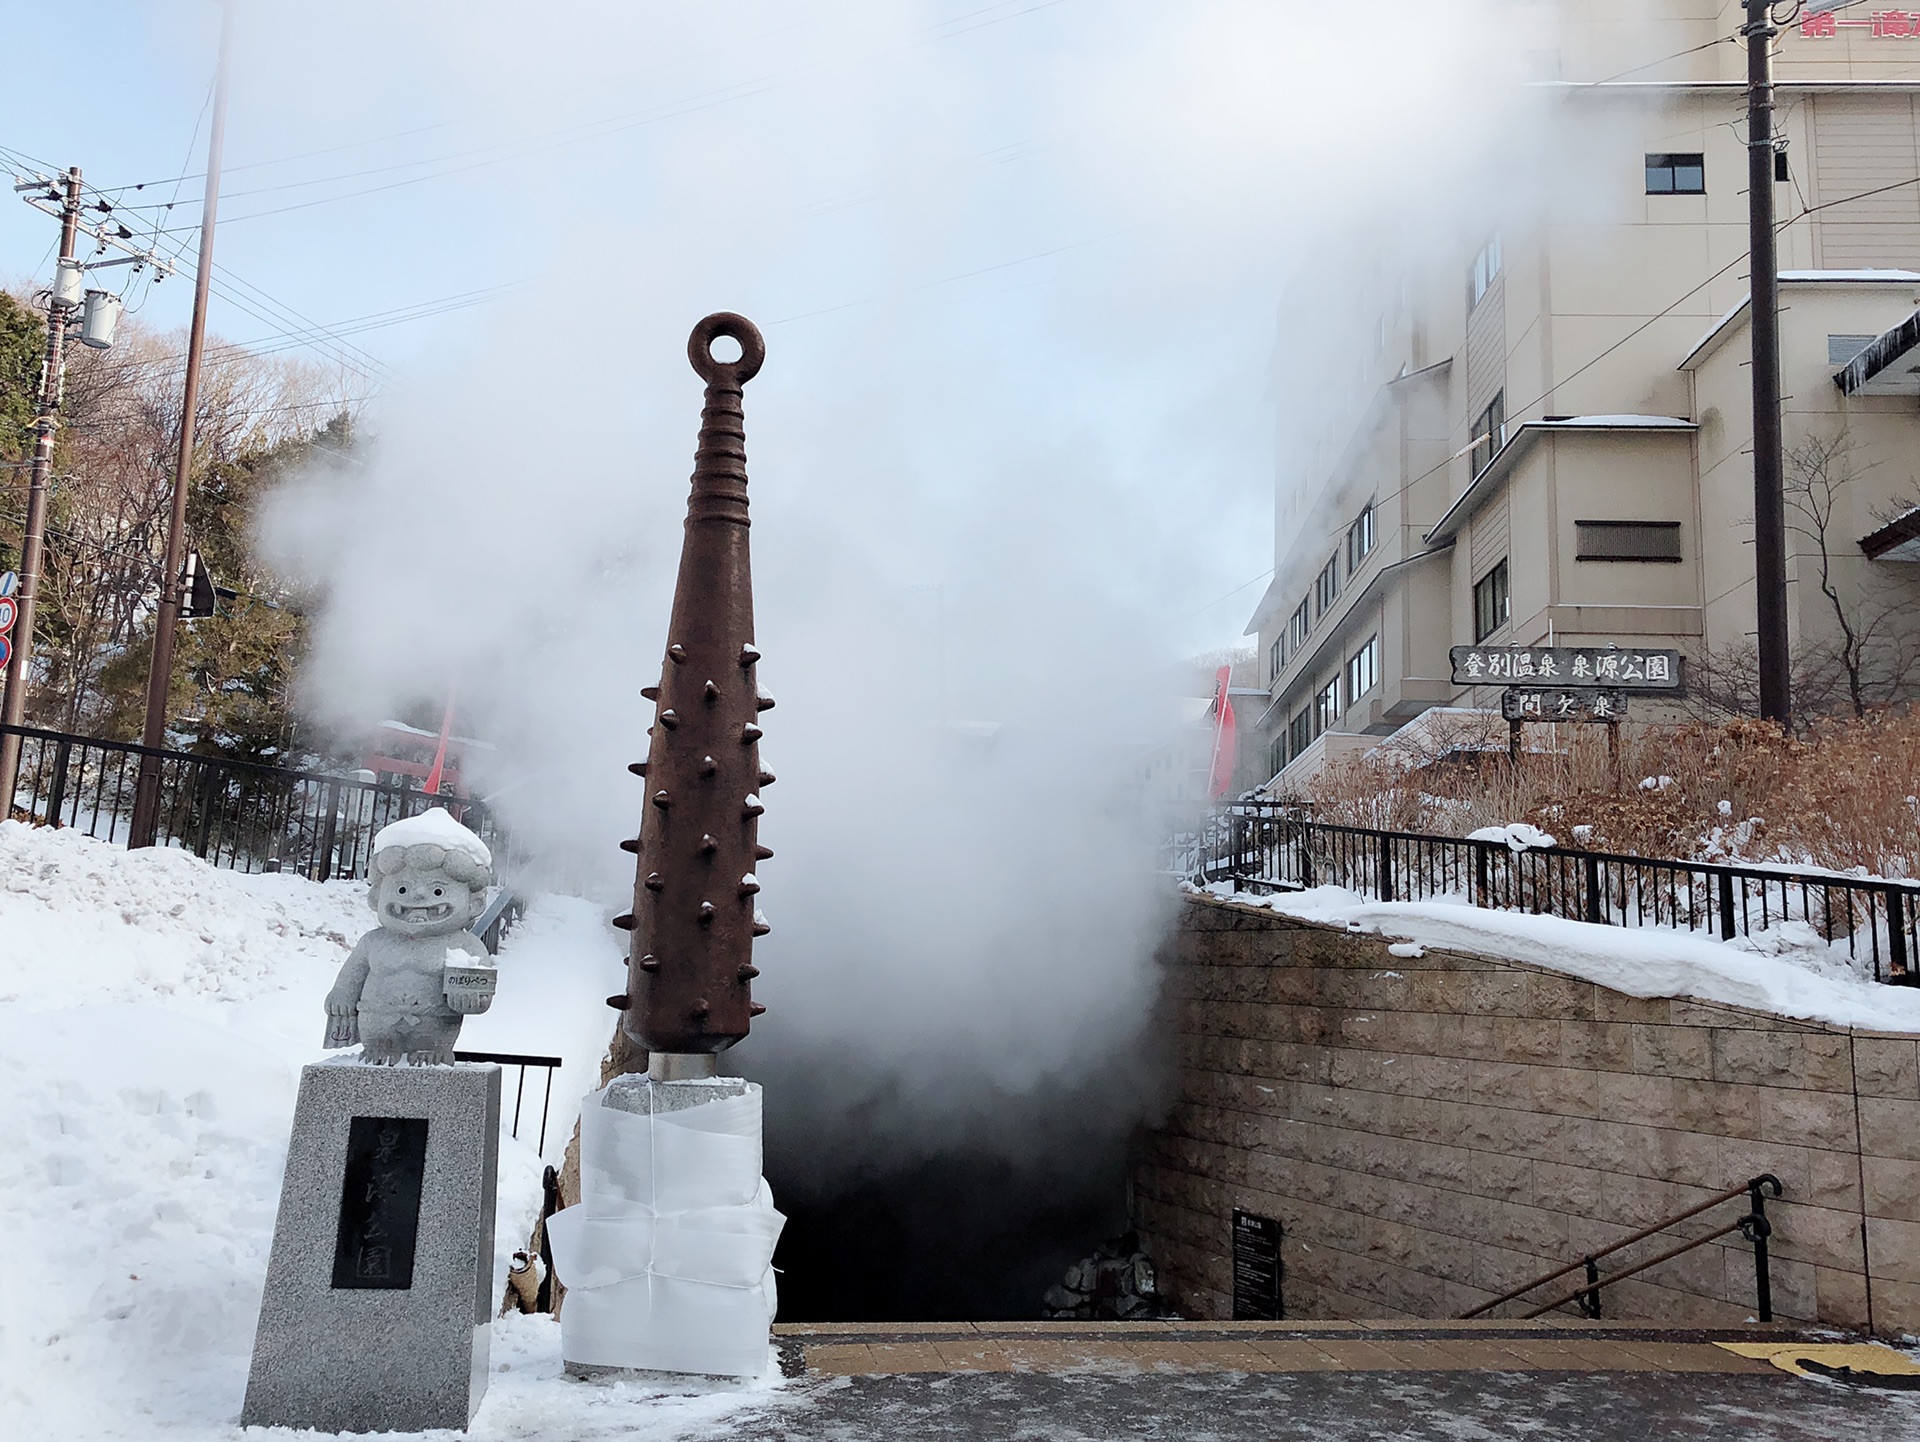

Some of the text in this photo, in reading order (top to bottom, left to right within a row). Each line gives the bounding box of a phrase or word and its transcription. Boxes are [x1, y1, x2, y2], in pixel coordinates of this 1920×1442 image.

[1463, 652, 1670, 681] 登別温泉 泉源公園
[447, 975, 488, 986] のぼりべつ
